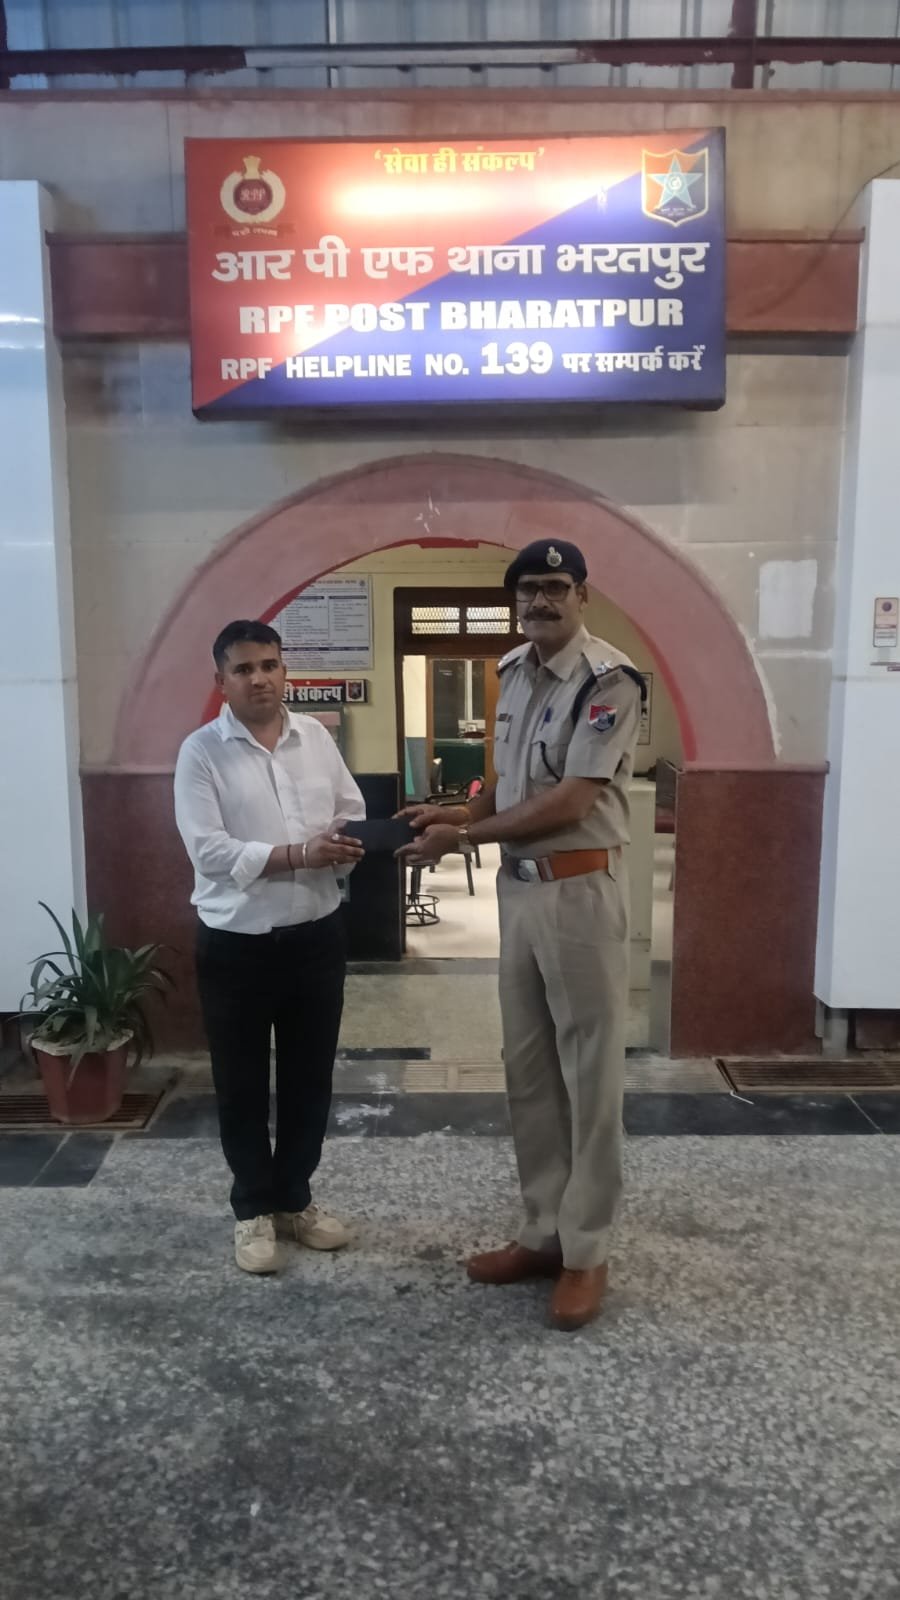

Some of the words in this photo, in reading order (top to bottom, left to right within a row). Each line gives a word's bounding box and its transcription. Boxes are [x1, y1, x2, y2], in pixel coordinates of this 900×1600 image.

[432, 147, 458, 173] ही
[212, 249, 295, 282] आर
[303, 235, 350, 278] पी
[361, 246, 434, 279] एफ
[448, 244, 545, 275] थाना
[557, 242, 710, 290] भरतपुर
[240, 304, 315, 334] RPF
[323, 302, 430, 332] POST
[441, 299, 684, 330] BHARATPUR
[221, 357, 272, 380] RPF
[286, 354, 412, 378] HELPLINE
[425, 353, 469, 376] NO.
[481, 341, 553, 375] 139
[562, 352, 592, 372] पर
[595, 345, 664, 371] सम्पर्क
[667, 345, 705, 371] करें
[297, 681, 343, 701] संकल्प
